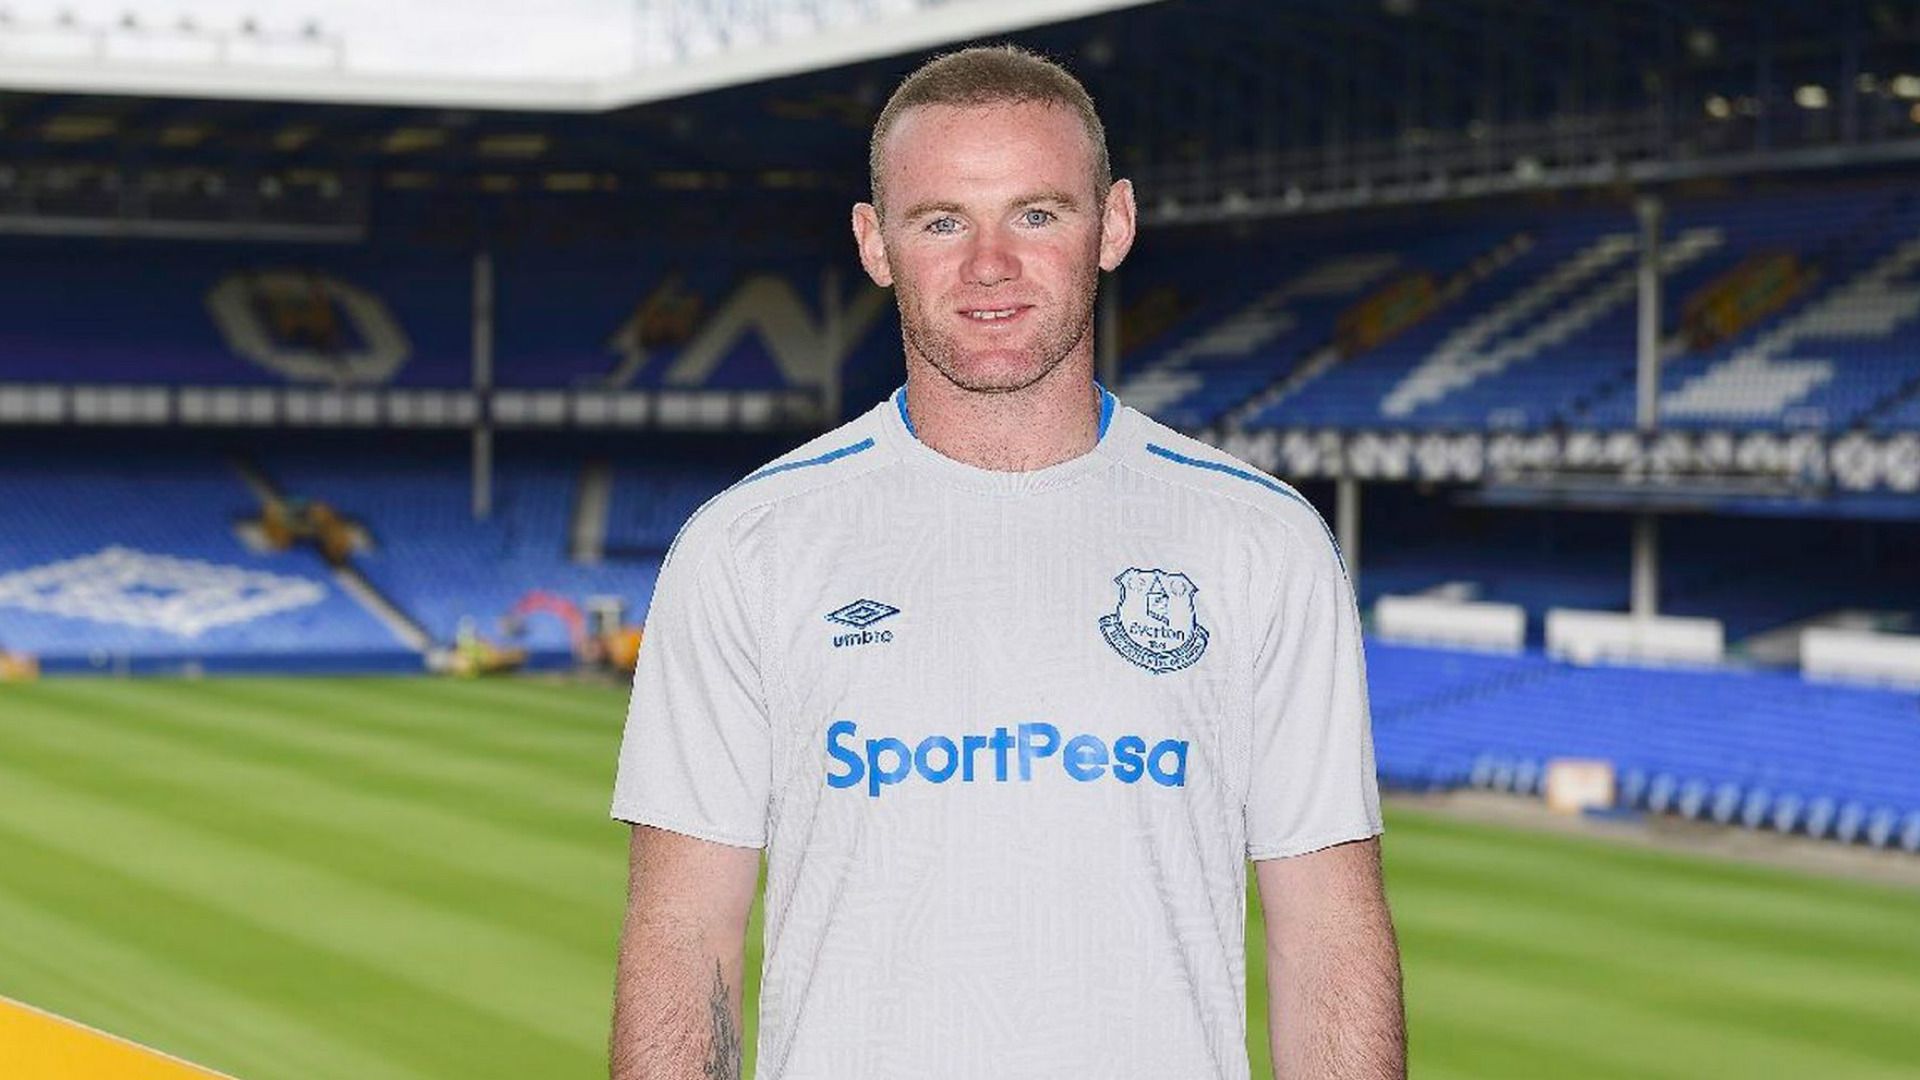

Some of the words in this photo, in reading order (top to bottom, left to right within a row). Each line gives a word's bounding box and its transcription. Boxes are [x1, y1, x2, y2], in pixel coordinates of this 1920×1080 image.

[833, 630, 893, 648] umbro
[1129, 621, 1185, 641] Everton
[826, 720, 1190, 798] SportPesa
